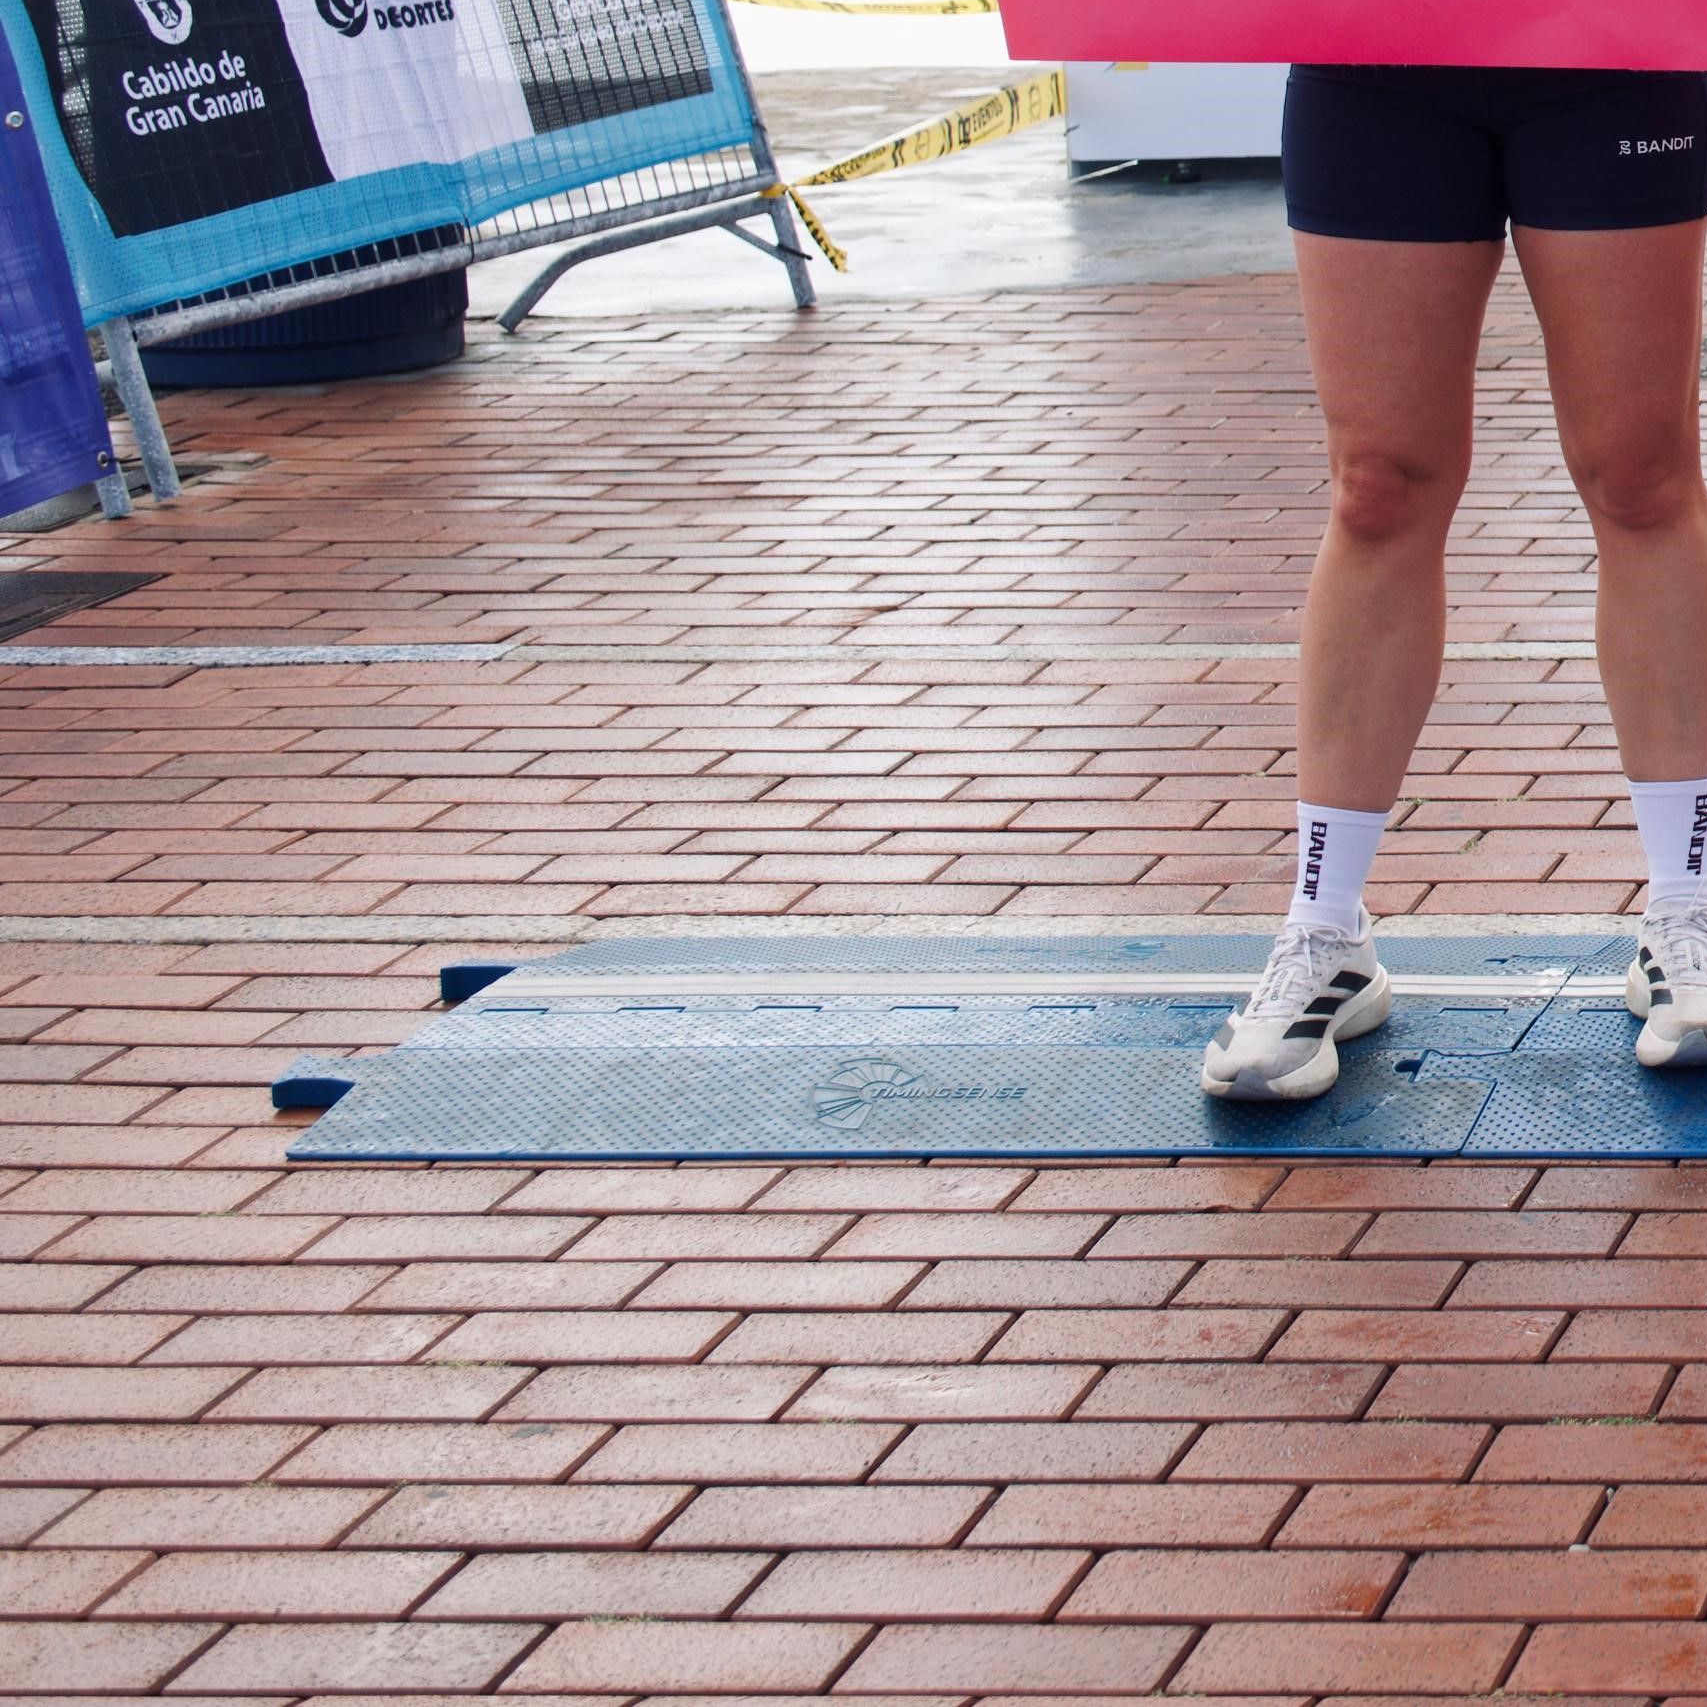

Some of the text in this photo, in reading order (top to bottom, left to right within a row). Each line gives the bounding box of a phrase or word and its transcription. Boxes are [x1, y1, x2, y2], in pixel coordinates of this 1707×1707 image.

[122, 50, 247, 102] Cabildo de
[125, 81, 266, 137] Gran Canaria
[1637, 136, 1695, 155] BANDIT
[1303, 821, 1328, 901] BANDIT
